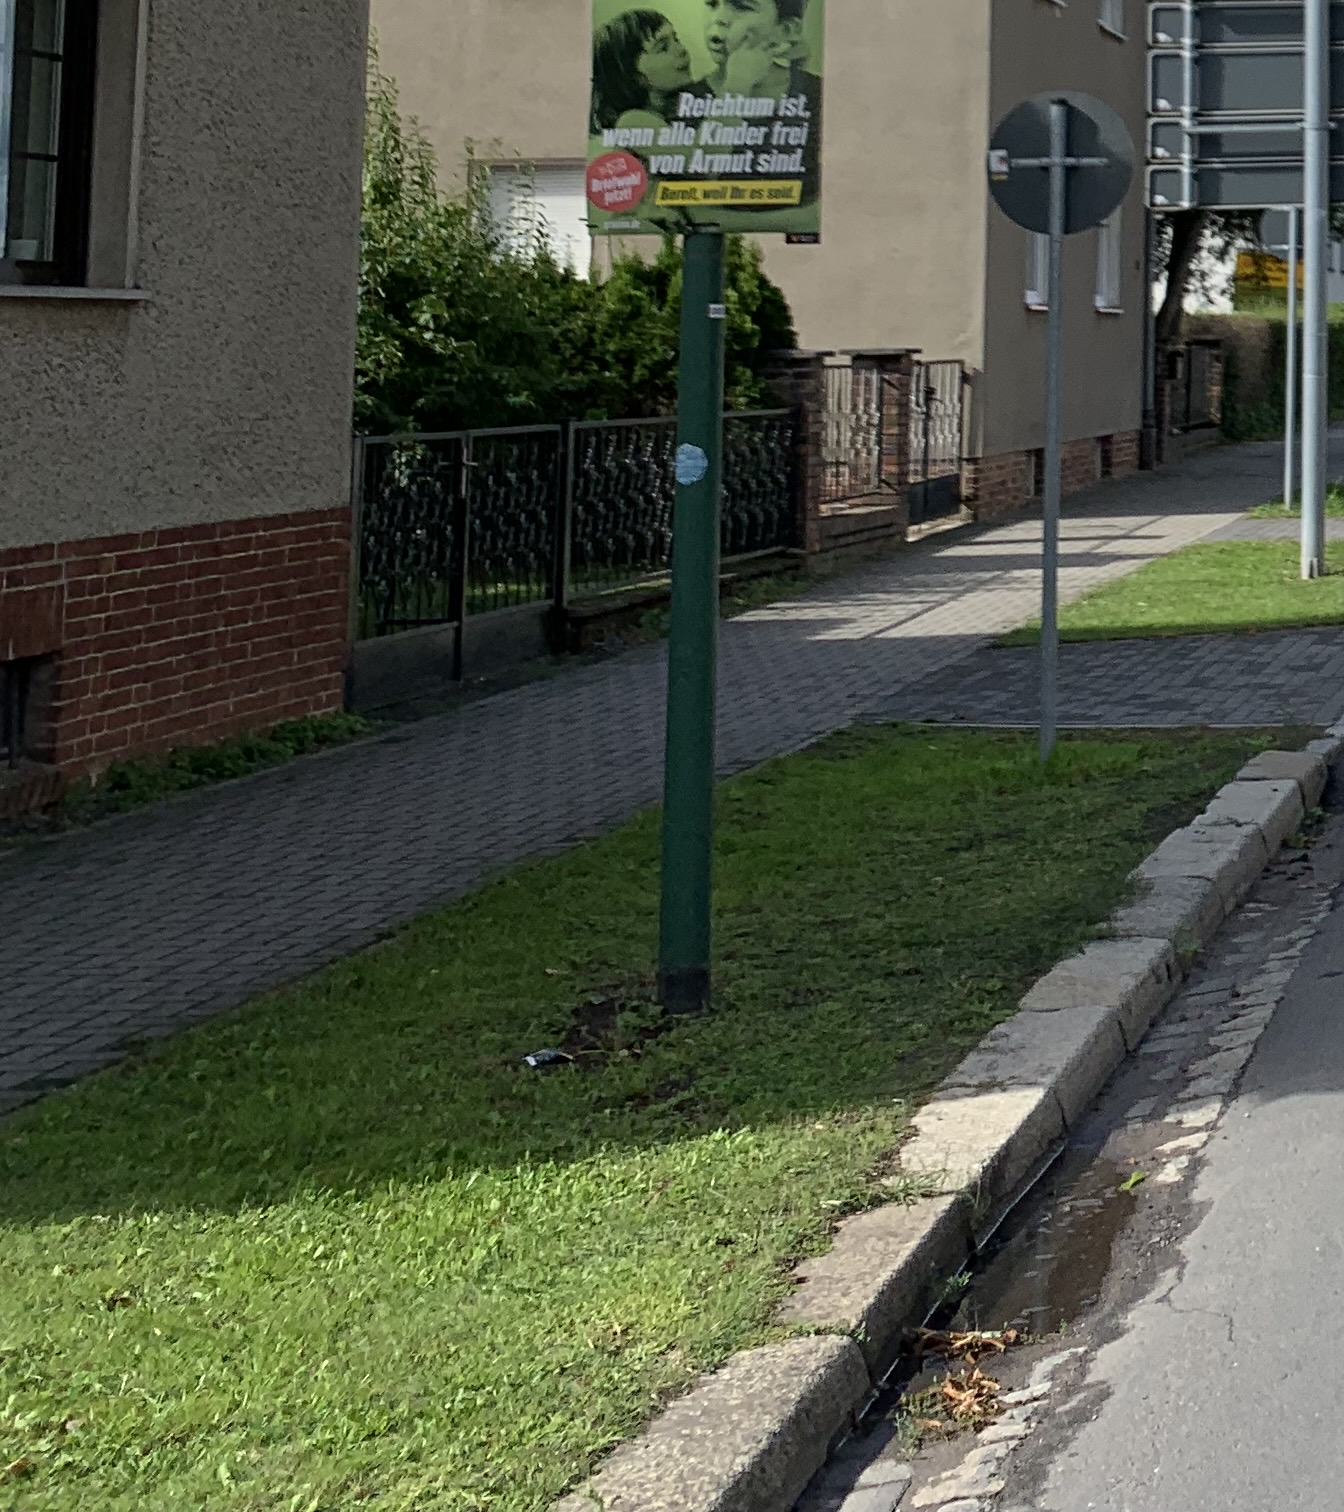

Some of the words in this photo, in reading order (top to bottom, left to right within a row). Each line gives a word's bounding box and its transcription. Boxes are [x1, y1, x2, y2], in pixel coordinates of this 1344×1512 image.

[678, 92, 776, 118] Reichtum
[602, 127, 655, 147] wenn
[657, 120, 696, 146] alle
[699, 119, 769, 146] Kinder
[769, 121, 809, 146] frei
[651, 154, 686, 175] von
[688, 148, 755, 174] Armut
[756, 148, 806, 174] sind.
